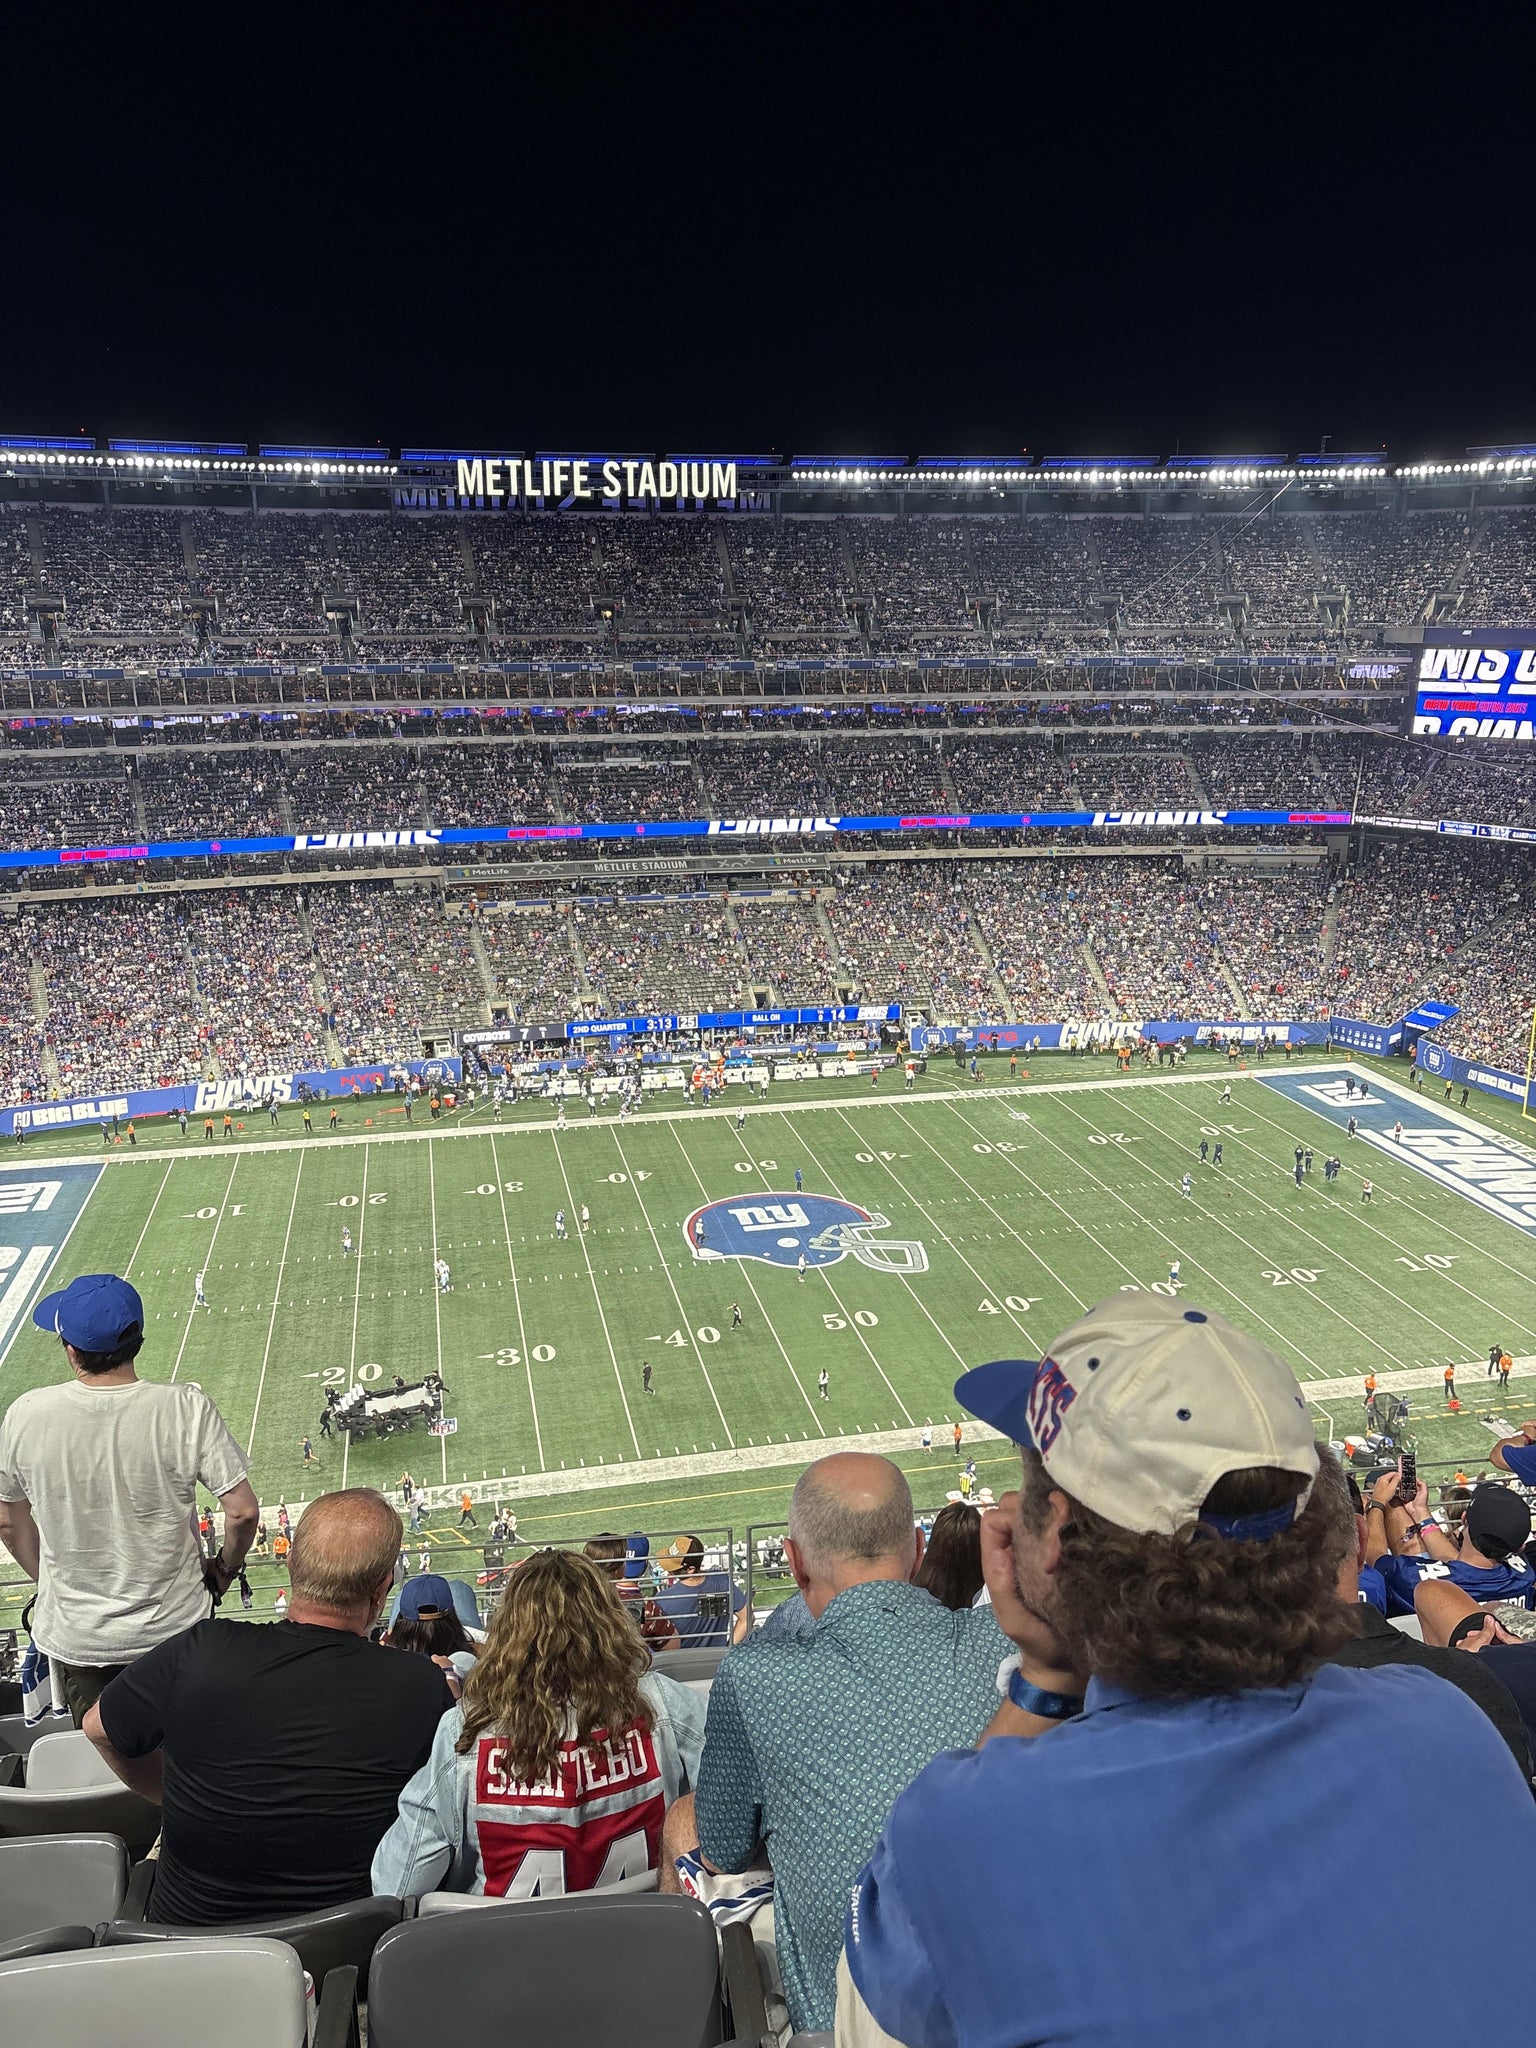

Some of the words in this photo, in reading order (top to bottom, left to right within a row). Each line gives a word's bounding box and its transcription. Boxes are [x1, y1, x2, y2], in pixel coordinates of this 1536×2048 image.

[457, 459, 592, 498] METLIFE
[602, 461, 737, 499] STADIUM
[594, 862, 639, 872] METLIFE
[641, 860, 688, 870] STADIUM
[782, 857, 817, 865] MetLife
[472, 868, 510, 876] MetLife
[147, 883, 171, 891] MetLife
[752, 1013, 769, 1022] BALL
[769, 1012, 781, 1021] ON
[830, 1008, 846, 1021] 14
[857, 1006, 889, 1019] GIANTS
[572, 1025, 589, 1034] 2ND
[590, 1022, 627, 1033] QUARTER
[646, 1018, 672, 1030] 3:13
[680, 1018, 695, 1028] 25
[462, 1030, 511, 1043] COWBOYS
[520, 1028, 529, 1040] 7
[1059, 1021, 1144, 1049] GIANTS
[1243, 1026, 1290, 1041] BLUE
[194, 1074, 293, 1113] GIANTS
[951, 1087, 1026, 1098] KICKOFF
[13, 1110, 31, 1132] GO
[31, 1105, 72, 1126] BIG
[71, 1097, 129, 1121] BLUE
[1394, 1253, 1452, 1272] 10
[1261, 1267, 1319, 1287] 20
[977, 1295, 1033, 1316] 40
[822, 1309, 880, 1331] 50
[664, 1325, 722, 1348] 40
[496, 1344, 557, 1366] 30
[320, 1363, 384, 1387] 20
